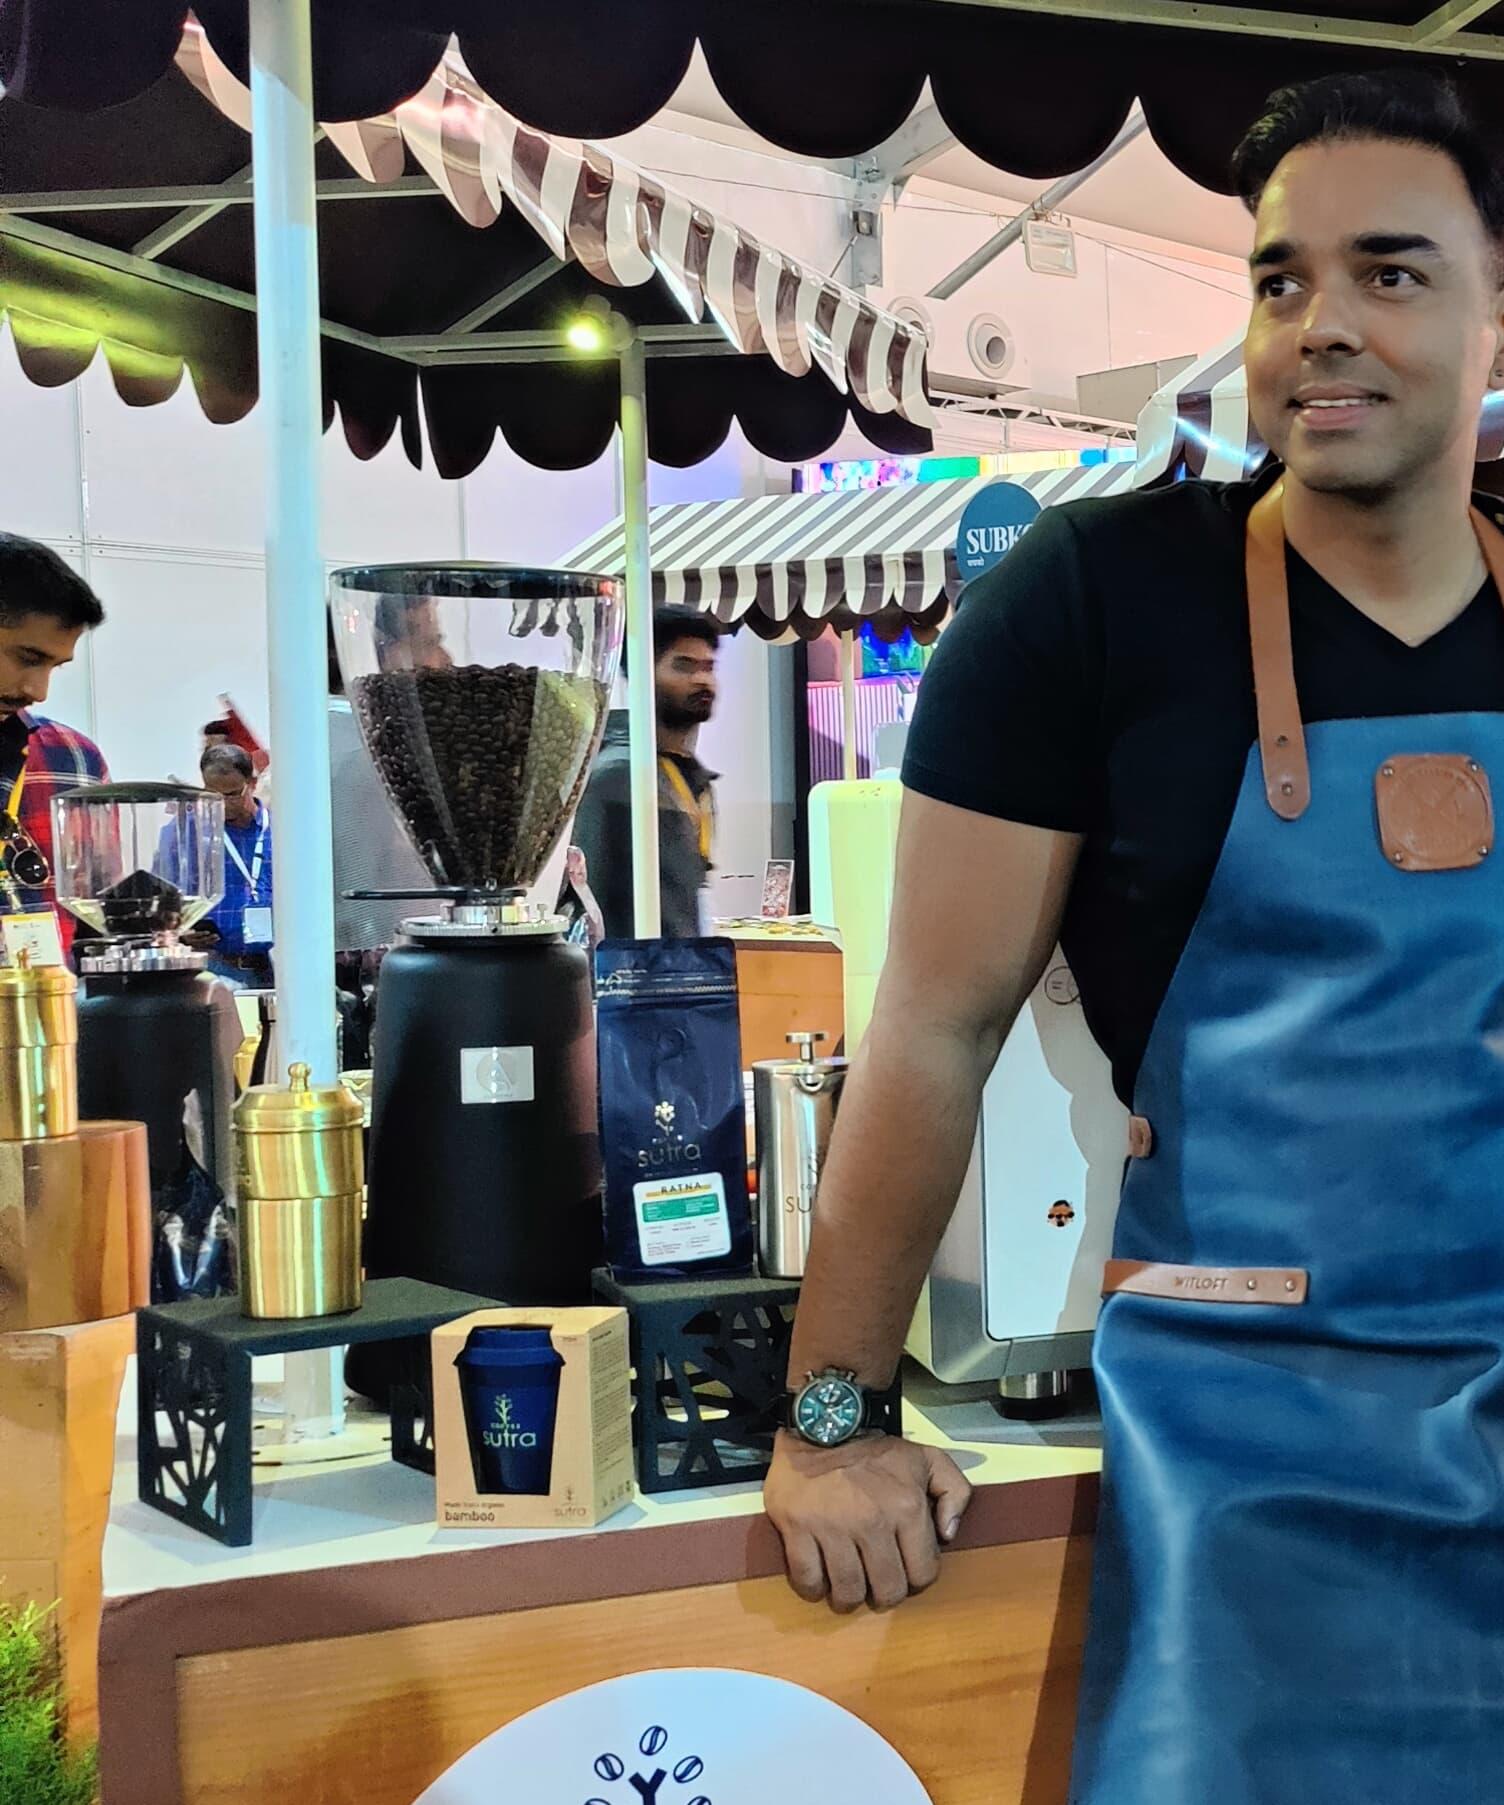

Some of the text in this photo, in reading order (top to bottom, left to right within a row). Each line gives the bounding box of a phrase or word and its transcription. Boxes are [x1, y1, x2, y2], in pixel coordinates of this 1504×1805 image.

[966, 524, 1033, 555] SUBK
[638, 1143, 702, 1168] sutra
[482, 1430, 537, 1449] sutra
[445, 1511, 496, 1522] bamboo
